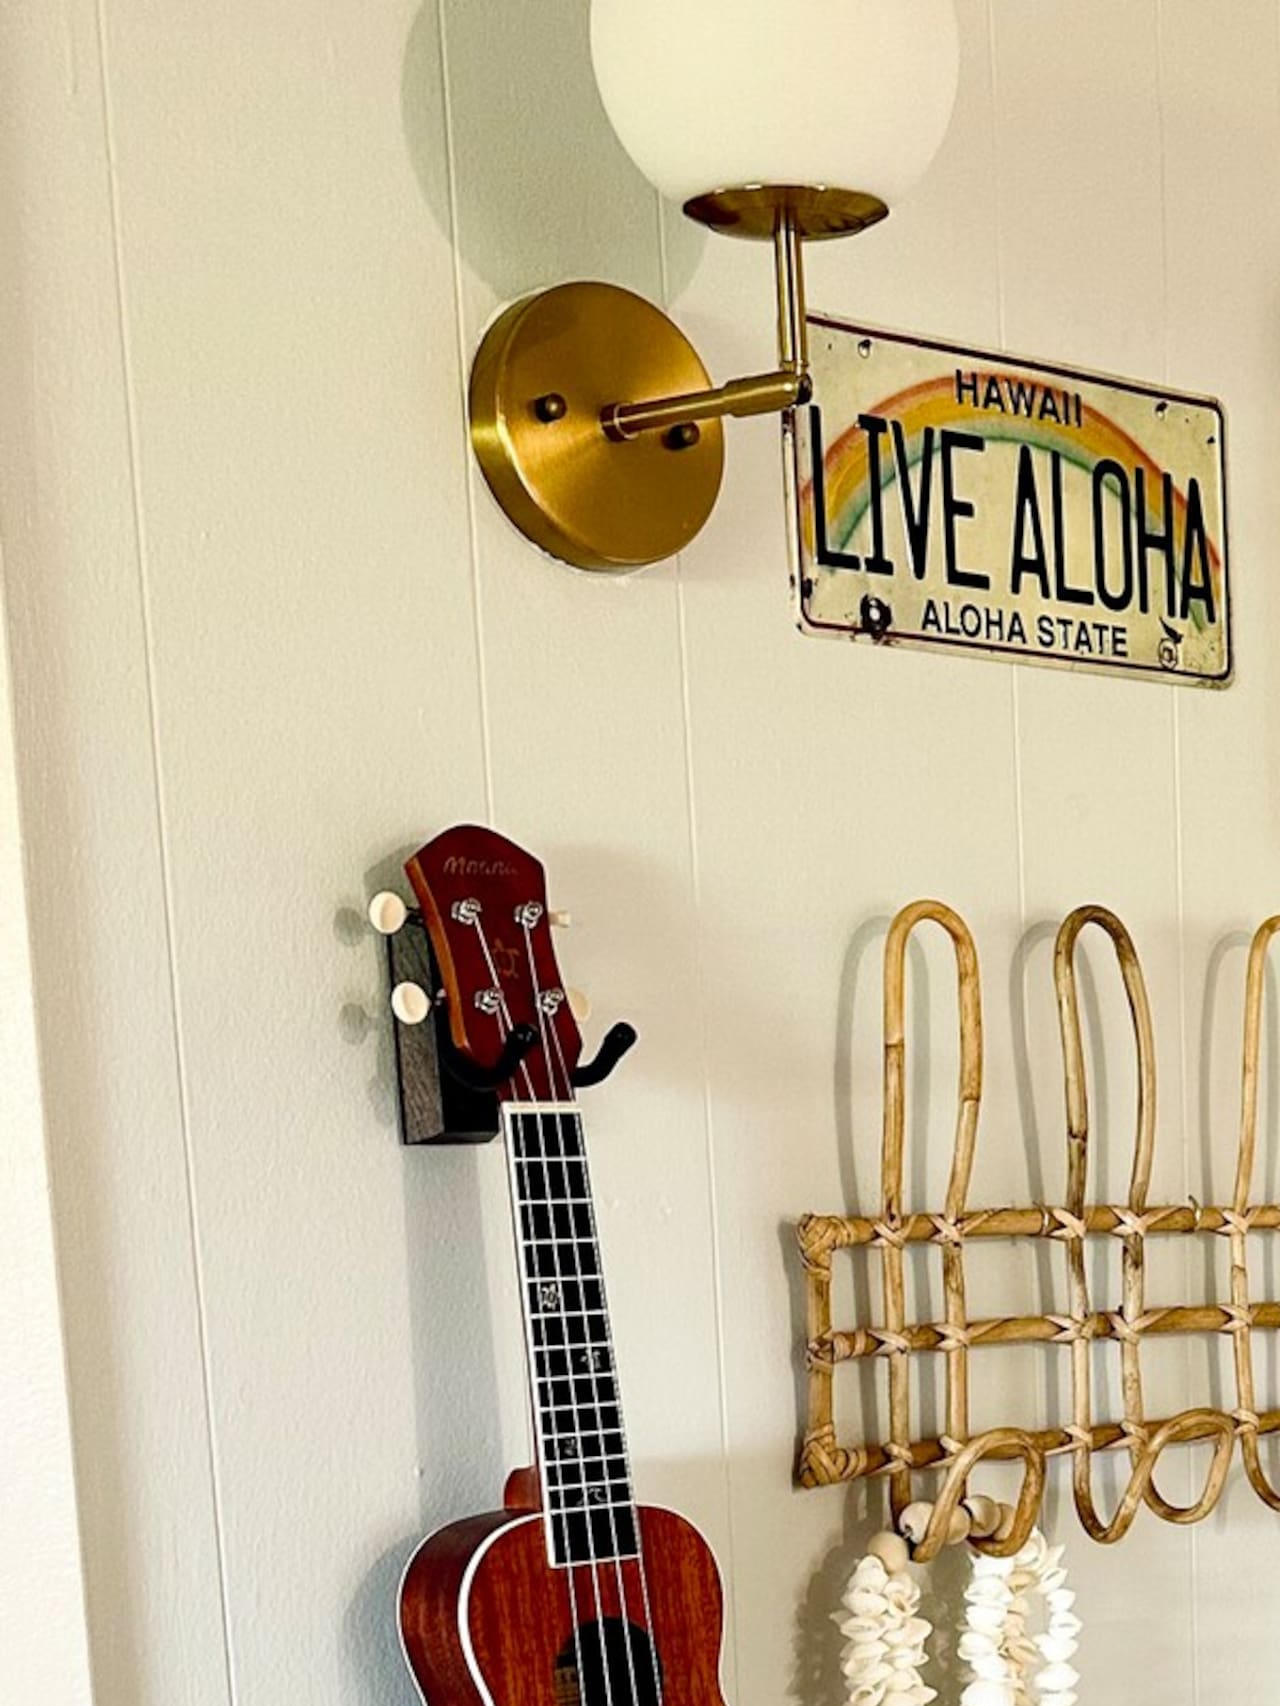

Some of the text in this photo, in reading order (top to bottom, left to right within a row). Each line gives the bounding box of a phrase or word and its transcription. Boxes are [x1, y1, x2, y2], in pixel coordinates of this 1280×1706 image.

[955, 369, 1083, 428] HAWAII
[810, 405, 1216, 623] LIVE ALOHA
[922, 600, 1128, 657] ALOHA STATE
